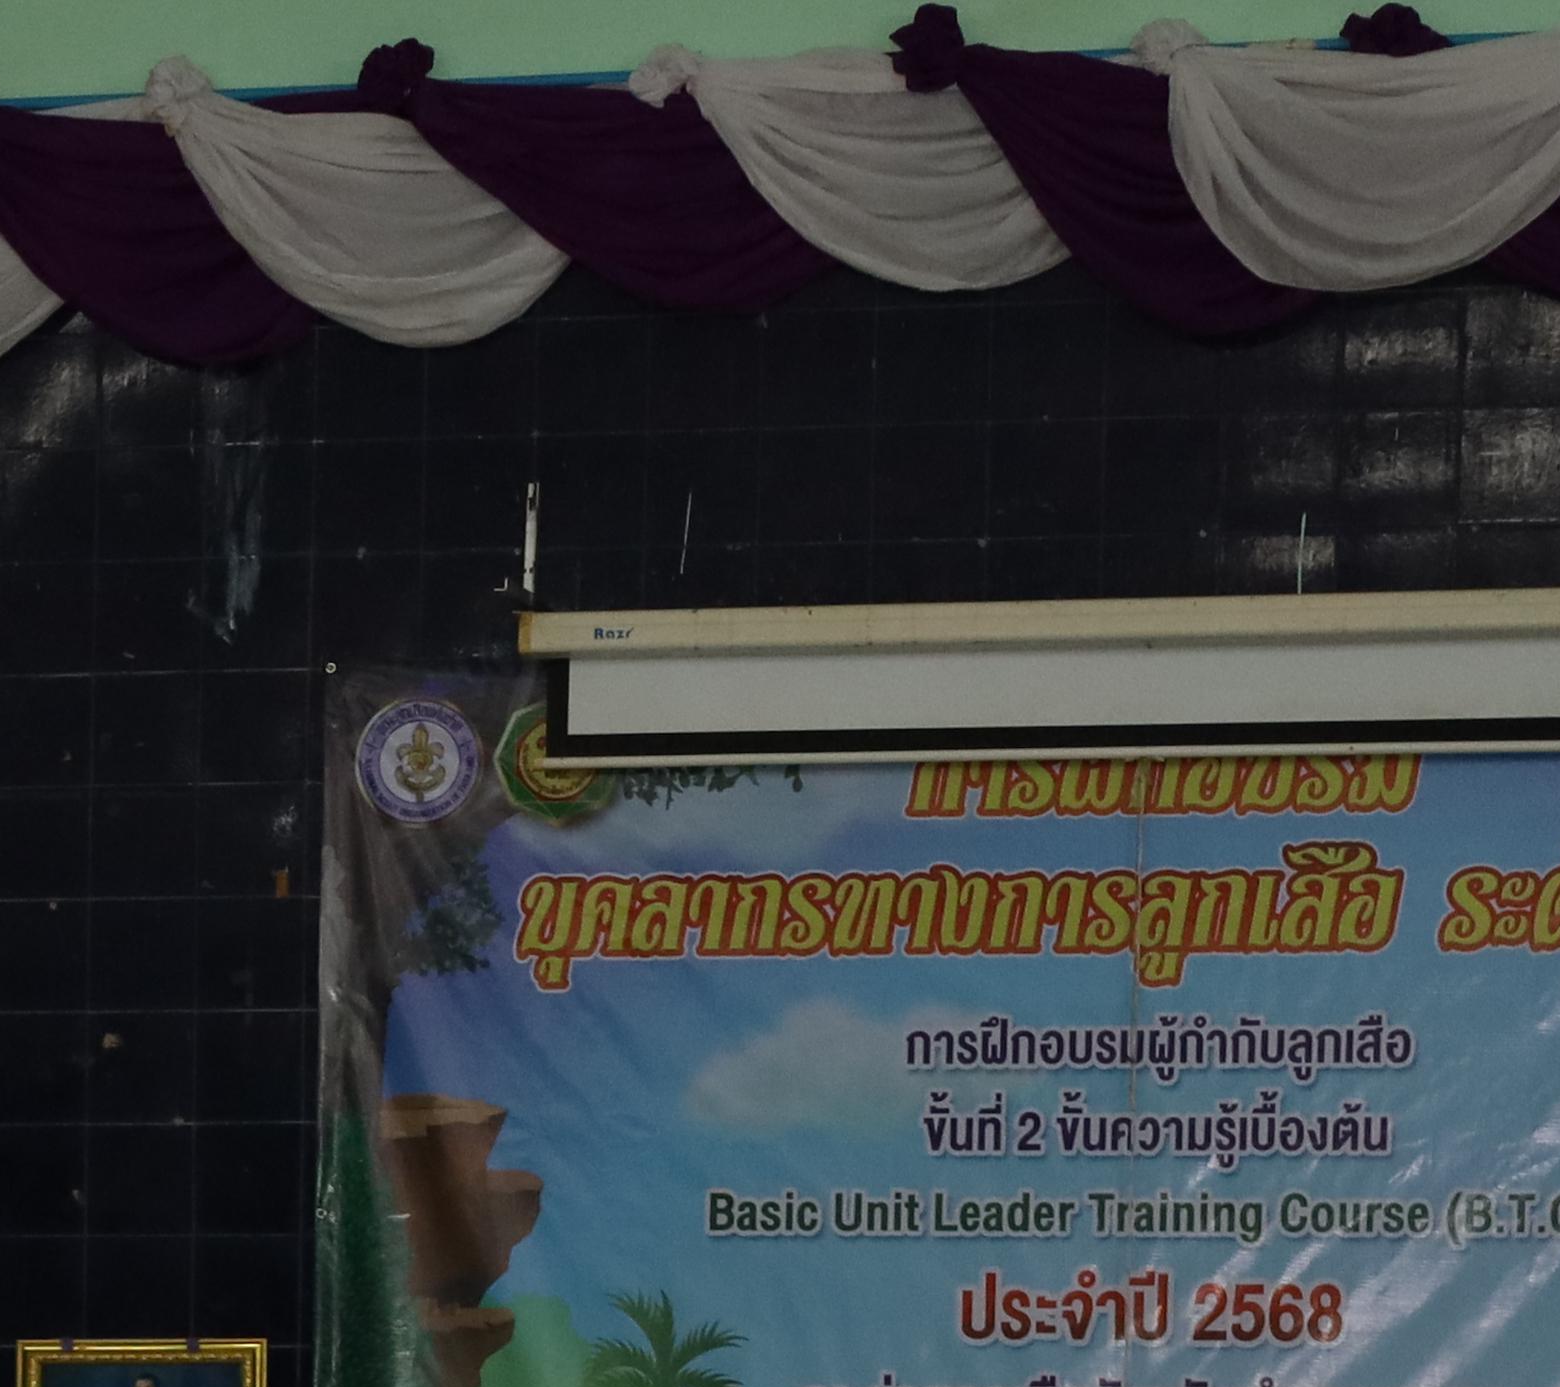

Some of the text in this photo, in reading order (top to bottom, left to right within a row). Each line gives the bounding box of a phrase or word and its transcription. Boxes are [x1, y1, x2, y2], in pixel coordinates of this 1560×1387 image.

[517, 841, 1404, 989] บุคลากรทางการลูกเสือ
[904, 1015, 1414, 1082] การฝึกอบรมผู้กำกับลูกเสือ
[923, 1090, 1390, 1168] ขั้นที่ 2 ขั้นความรู้เบื้องต้น
[707, 1191, 819, 1233] Basic
[833, 1191, 920, 1233] Unit
[934, 1192, 1076, 1233] Leader
[1088, 1192, 1263, 1242] Training
[1280, 1193, 1431, 1234] Course
[959, 1270, 1344, 1342] ประจำปี 2568
